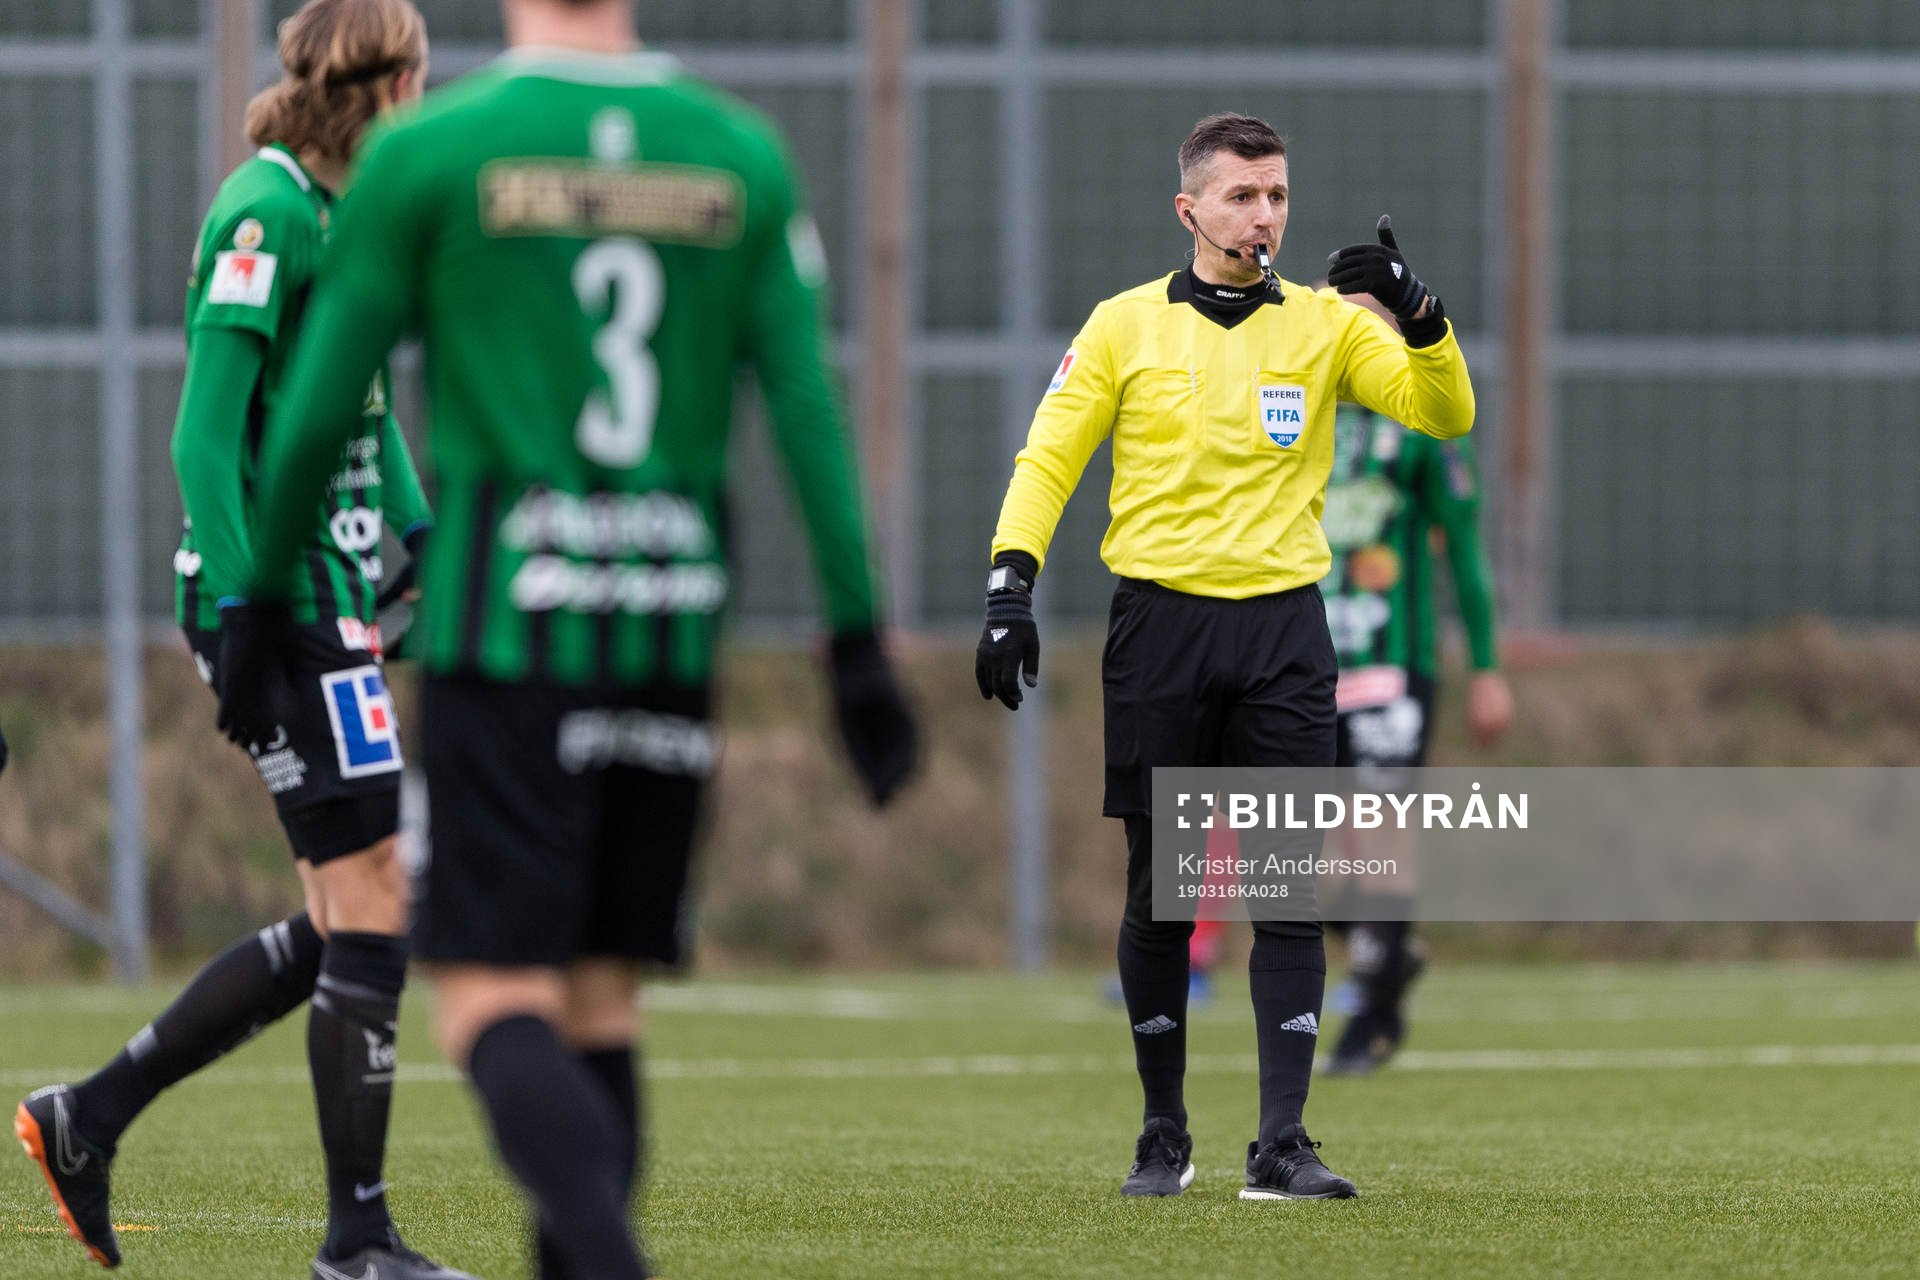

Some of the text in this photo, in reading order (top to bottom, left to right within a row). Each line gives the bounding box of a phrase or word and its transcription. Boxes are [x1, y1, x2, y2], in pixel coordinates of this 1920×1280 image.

[1216, 290, 1240, 299] CRAFT
[571, 236, 666, 469] 3
[1262, 390, 1302, 399] REFEREE
[1266, 408, 1300, 422] FIFA
[1277, 435, 1293, 443] 2018
[1134, 1020, 1177, 1034] adidas
